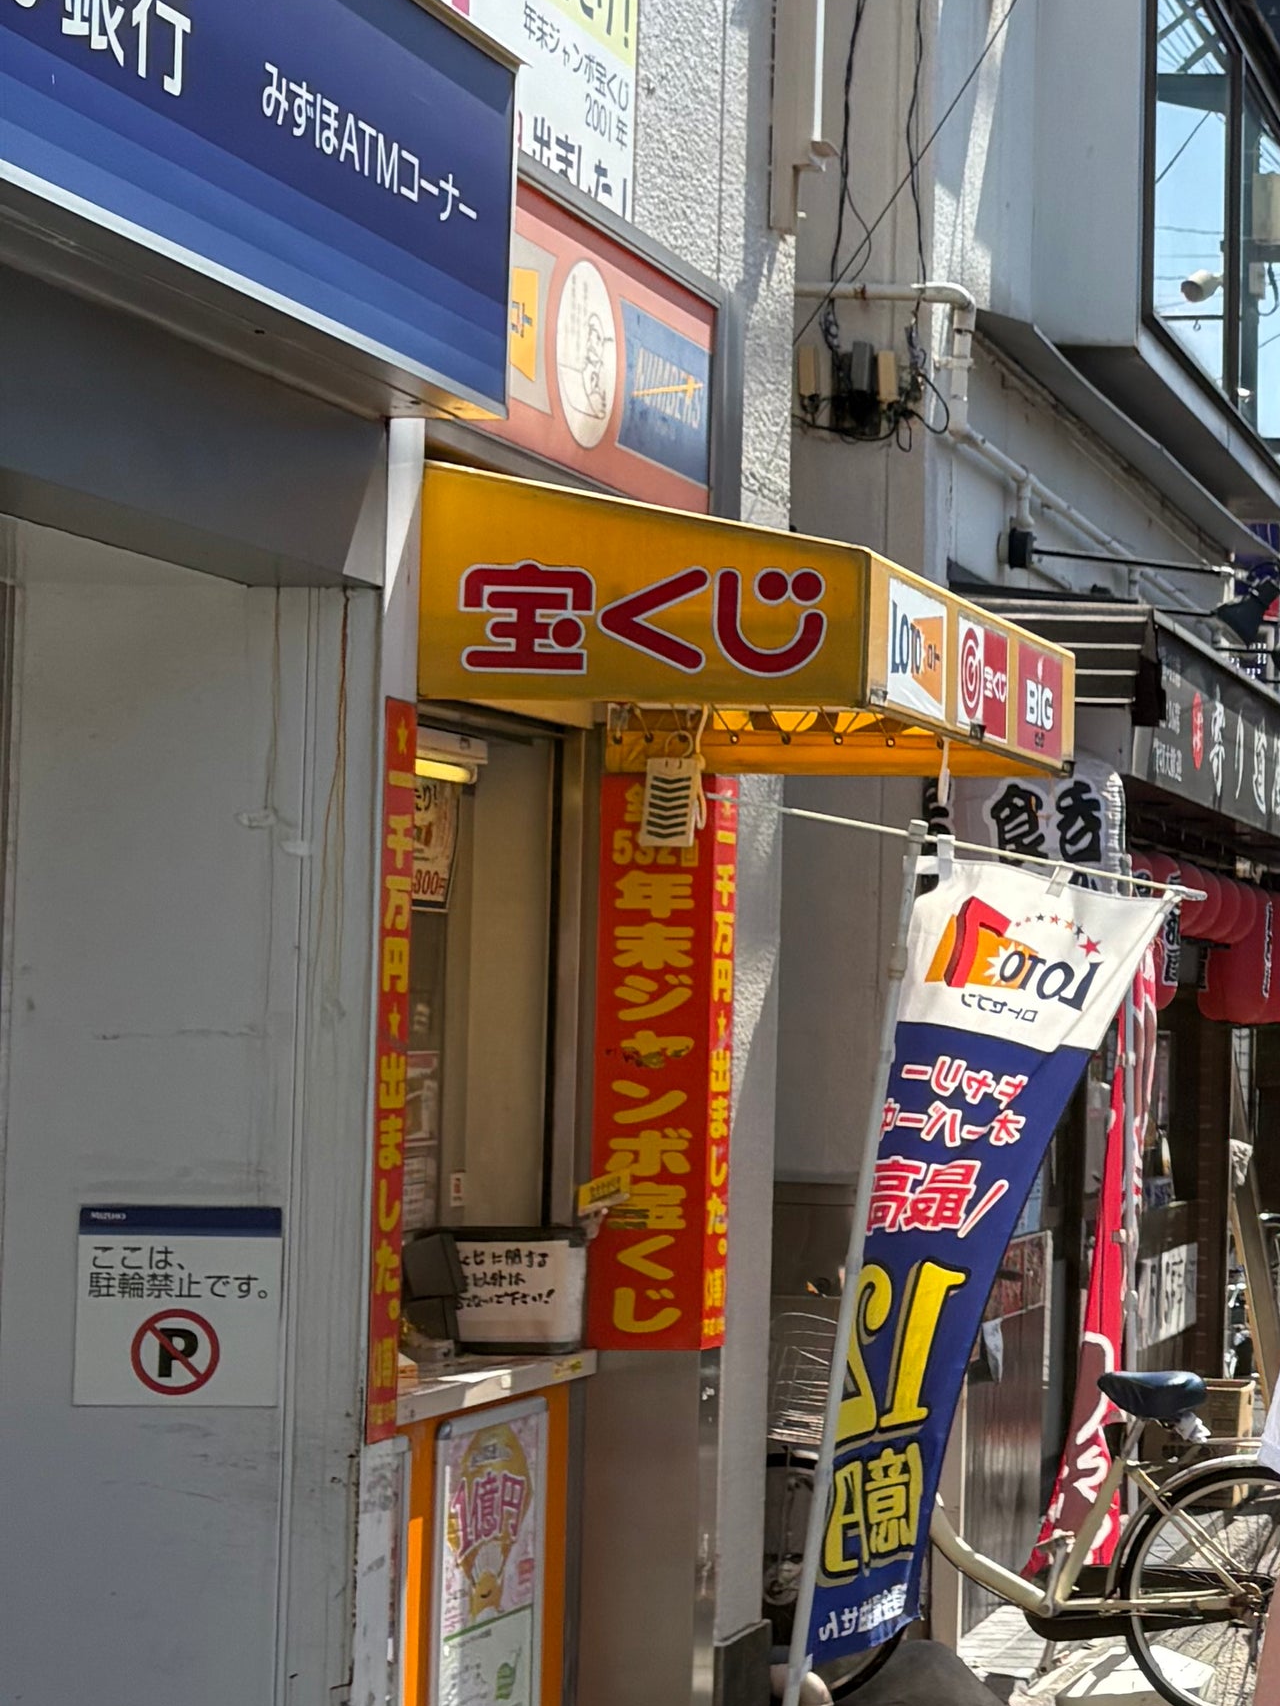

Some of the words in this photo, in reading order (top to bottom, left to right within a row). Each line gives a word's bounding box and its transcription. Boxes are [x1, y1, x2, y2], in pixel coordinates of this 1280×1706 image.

[523, 1, 630, 107] 年末ジャンボ宝くじ
[262, 61, 478, 224] みずほATMコーナー
[458, 559, 829, 677] 宝くじ
[890, 600, 922, 676] LOTO
[984, 666, 1007, 703] 宝くじ
[1026, 678, 1054, 731] BIG
[88, 1272, 268, 1299] 駐輪禁止です。
[92, 1246, 186, 1271] ここは、
[450, 1470, 526, 1565] 1億円
